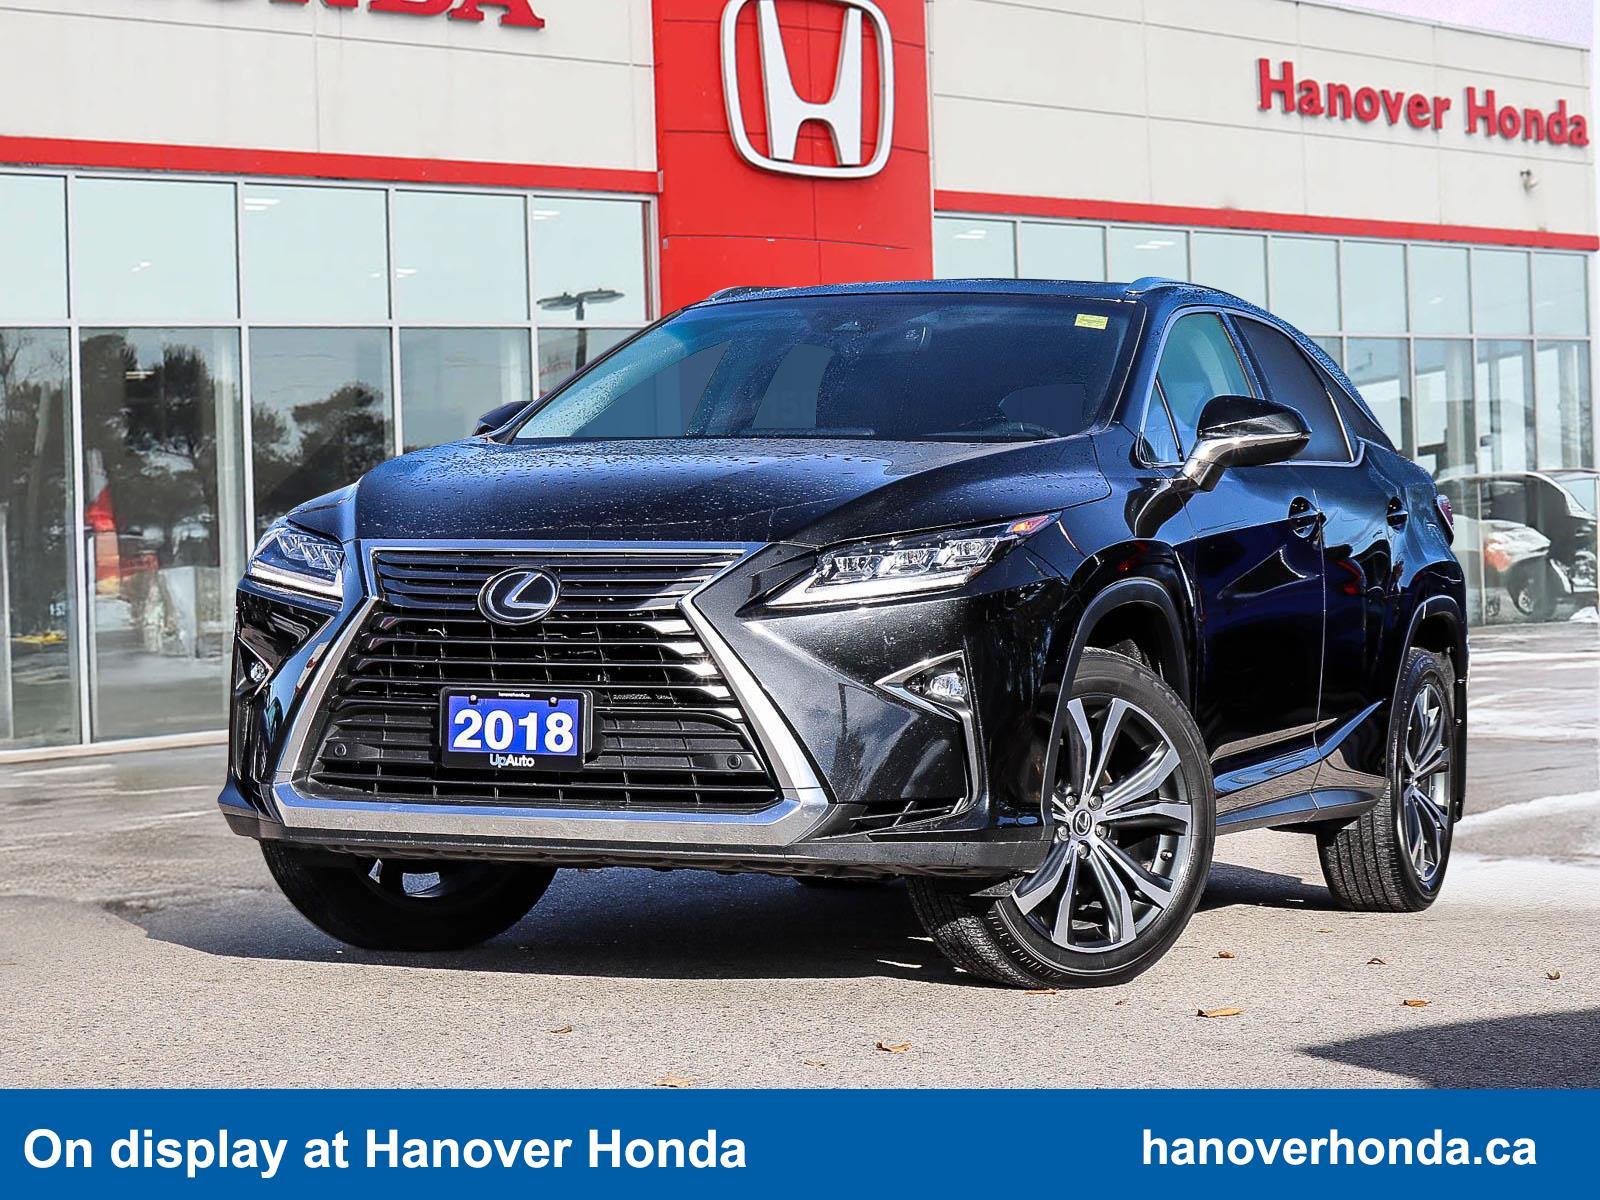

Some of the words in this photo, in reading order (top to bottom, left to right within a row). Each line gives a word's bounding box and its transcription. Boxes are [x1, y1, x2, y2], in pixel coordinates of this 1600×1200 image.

[1257, 58, 1453, 130] Hanover
[1465, 86, 1590, 147] Honda
[453, 708, 574, 753] 2018
[489, 753, 535, 768] UpAuto
